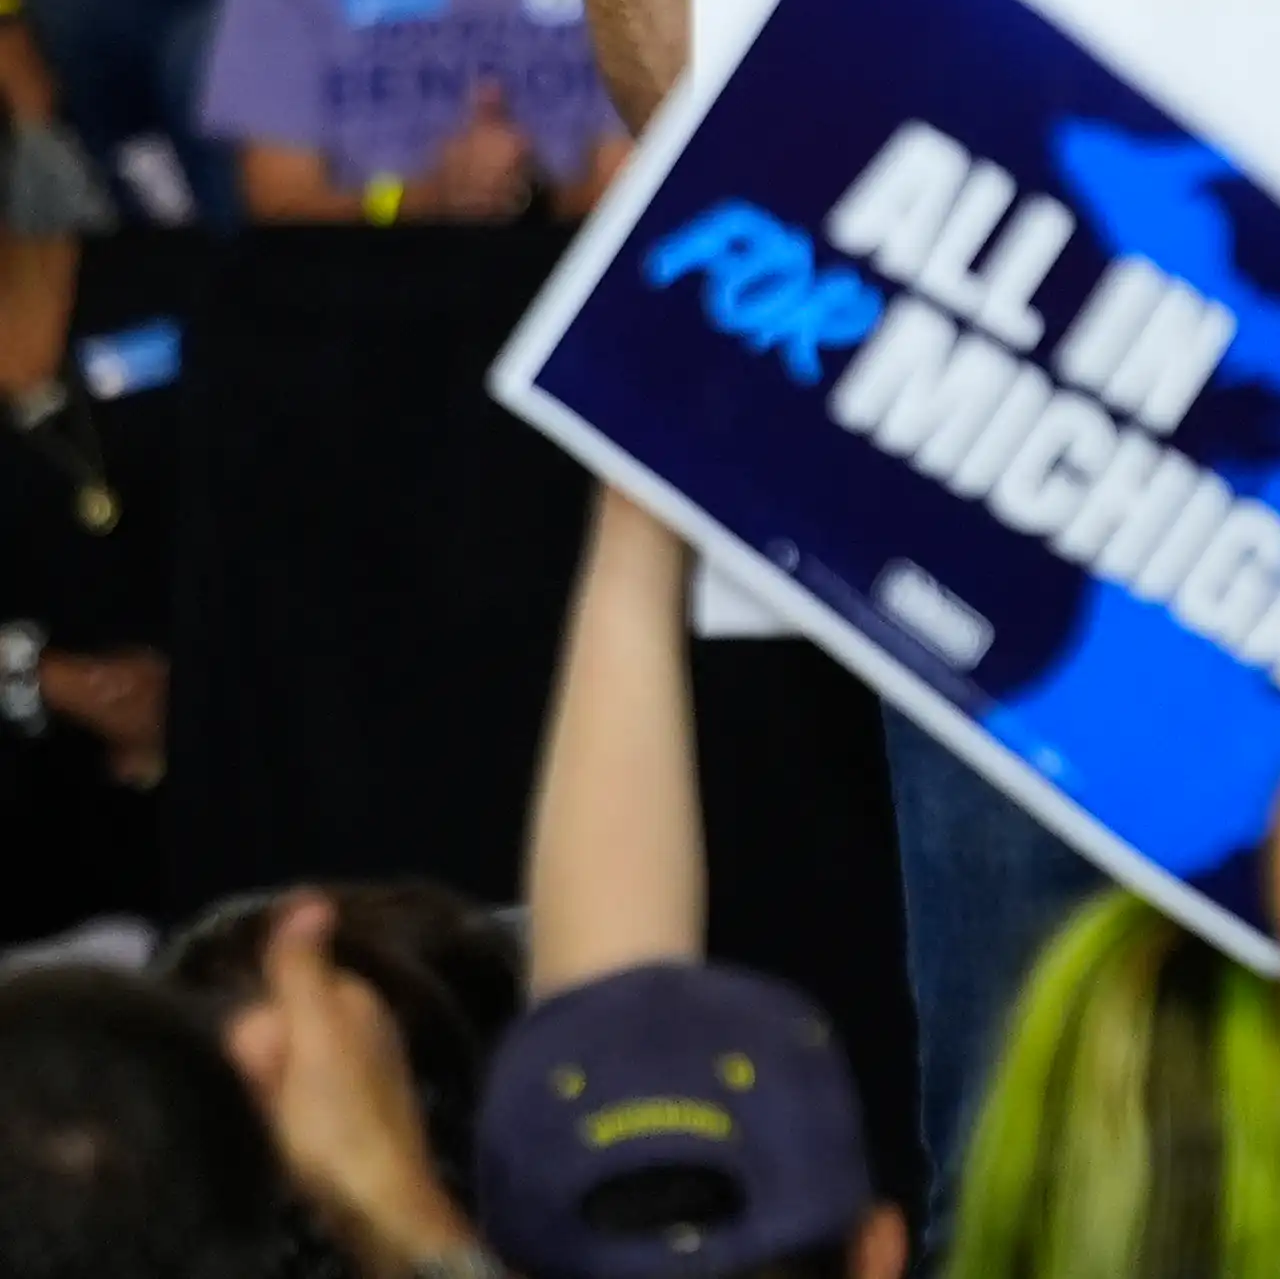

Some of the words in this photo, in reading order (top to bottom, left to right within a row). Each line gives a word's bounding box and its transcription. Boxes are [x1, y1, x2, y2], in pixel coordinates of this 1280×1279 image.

[642, 198, 884, 385] FOR
[826, 120, 1076, 352] ALL
[1053, 253, 1238, 437] IN
